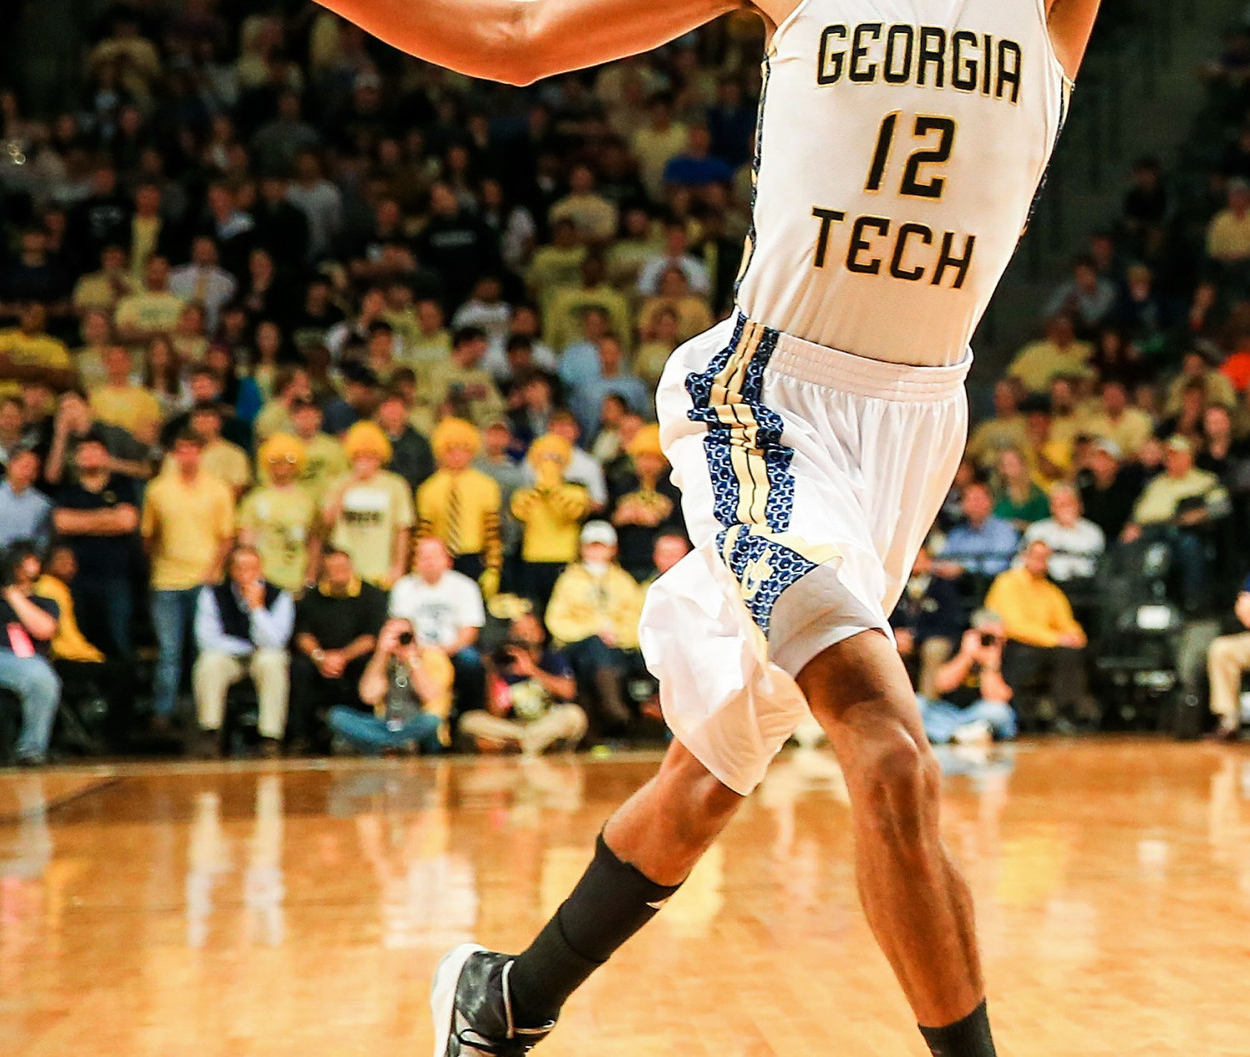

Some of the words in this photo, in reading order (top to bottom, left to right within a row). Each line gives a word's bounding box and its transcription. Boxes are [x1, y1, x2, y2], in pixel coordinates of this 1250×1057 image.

[816, 21, 1024, 107] GEORGIA
[862, 109, 959, 202] 12
[811, 205, 977, 291] TECH
